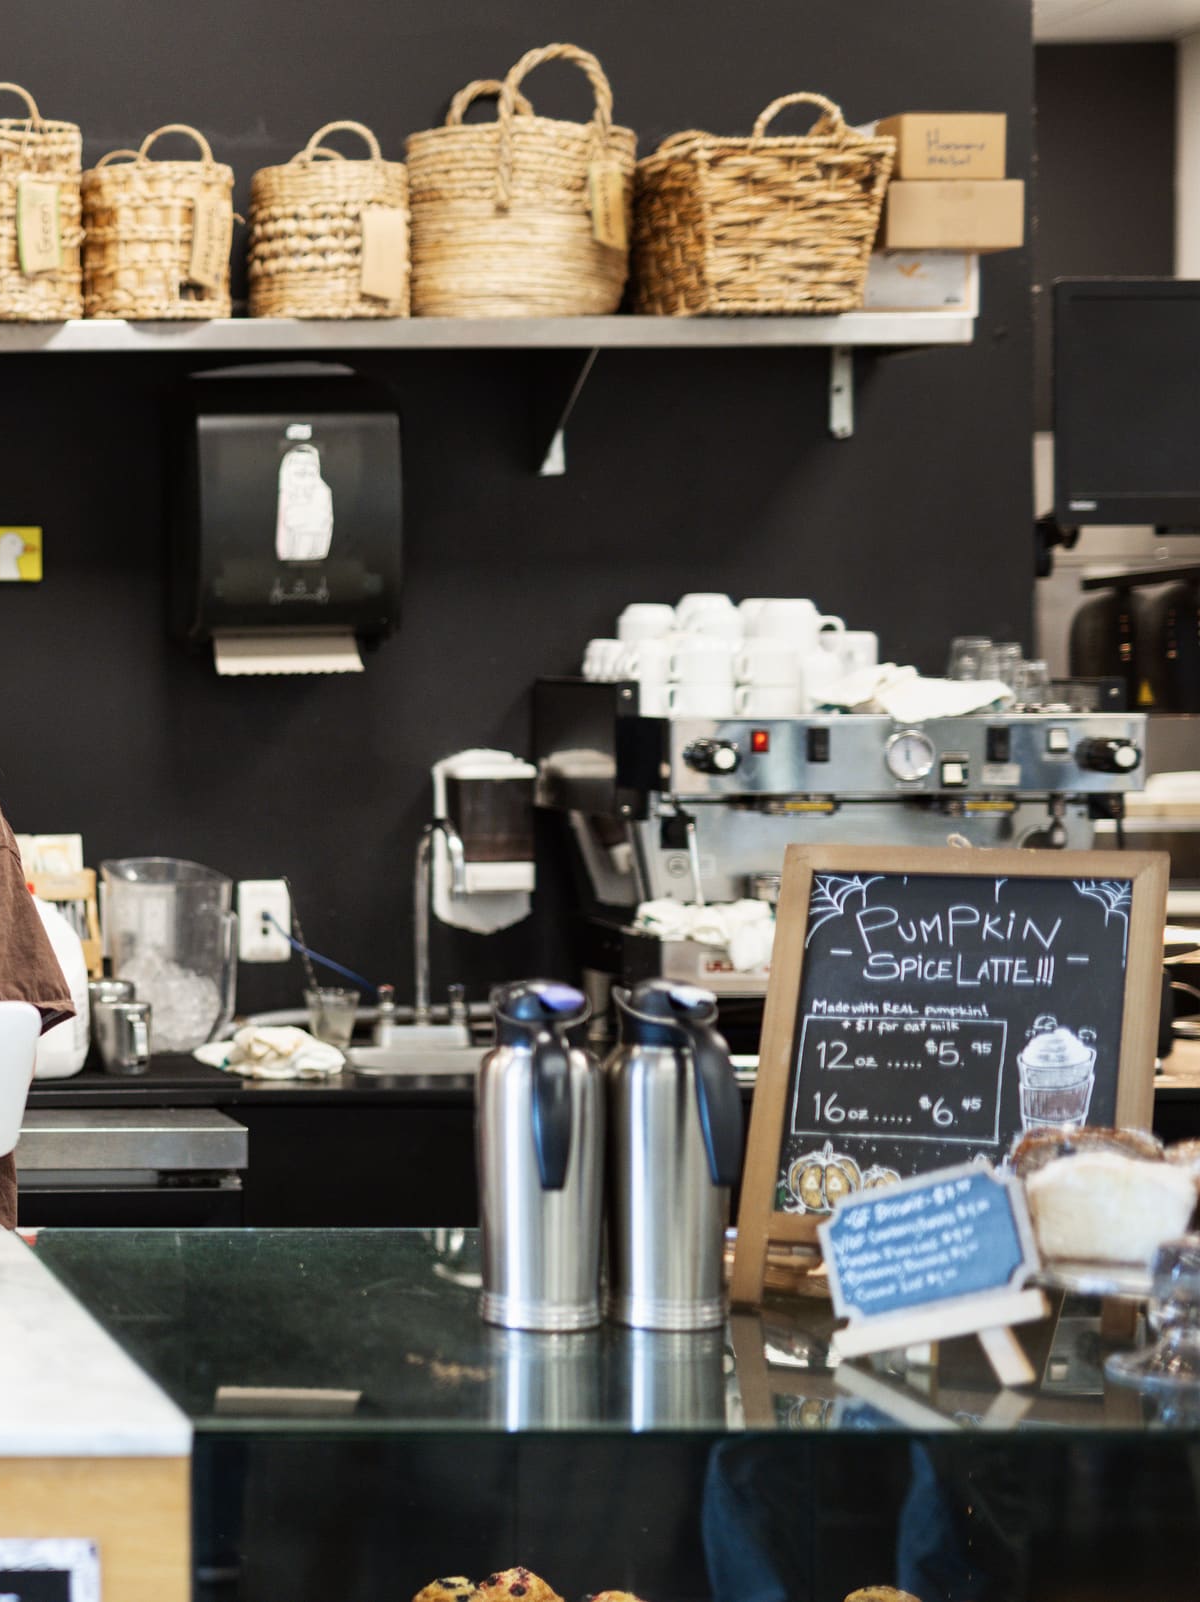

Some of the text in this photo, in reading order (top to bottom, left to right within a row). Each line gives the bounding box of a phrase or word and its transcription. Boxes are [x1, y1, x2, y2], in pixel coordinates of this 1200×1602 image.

[812, 998, 989, 1017] Made with REAL pumpkin!
[877, 1021, 898, 1036] for
[904, 1021, 927, 1031] oat
[930, 1020, 960, 1032] milk
